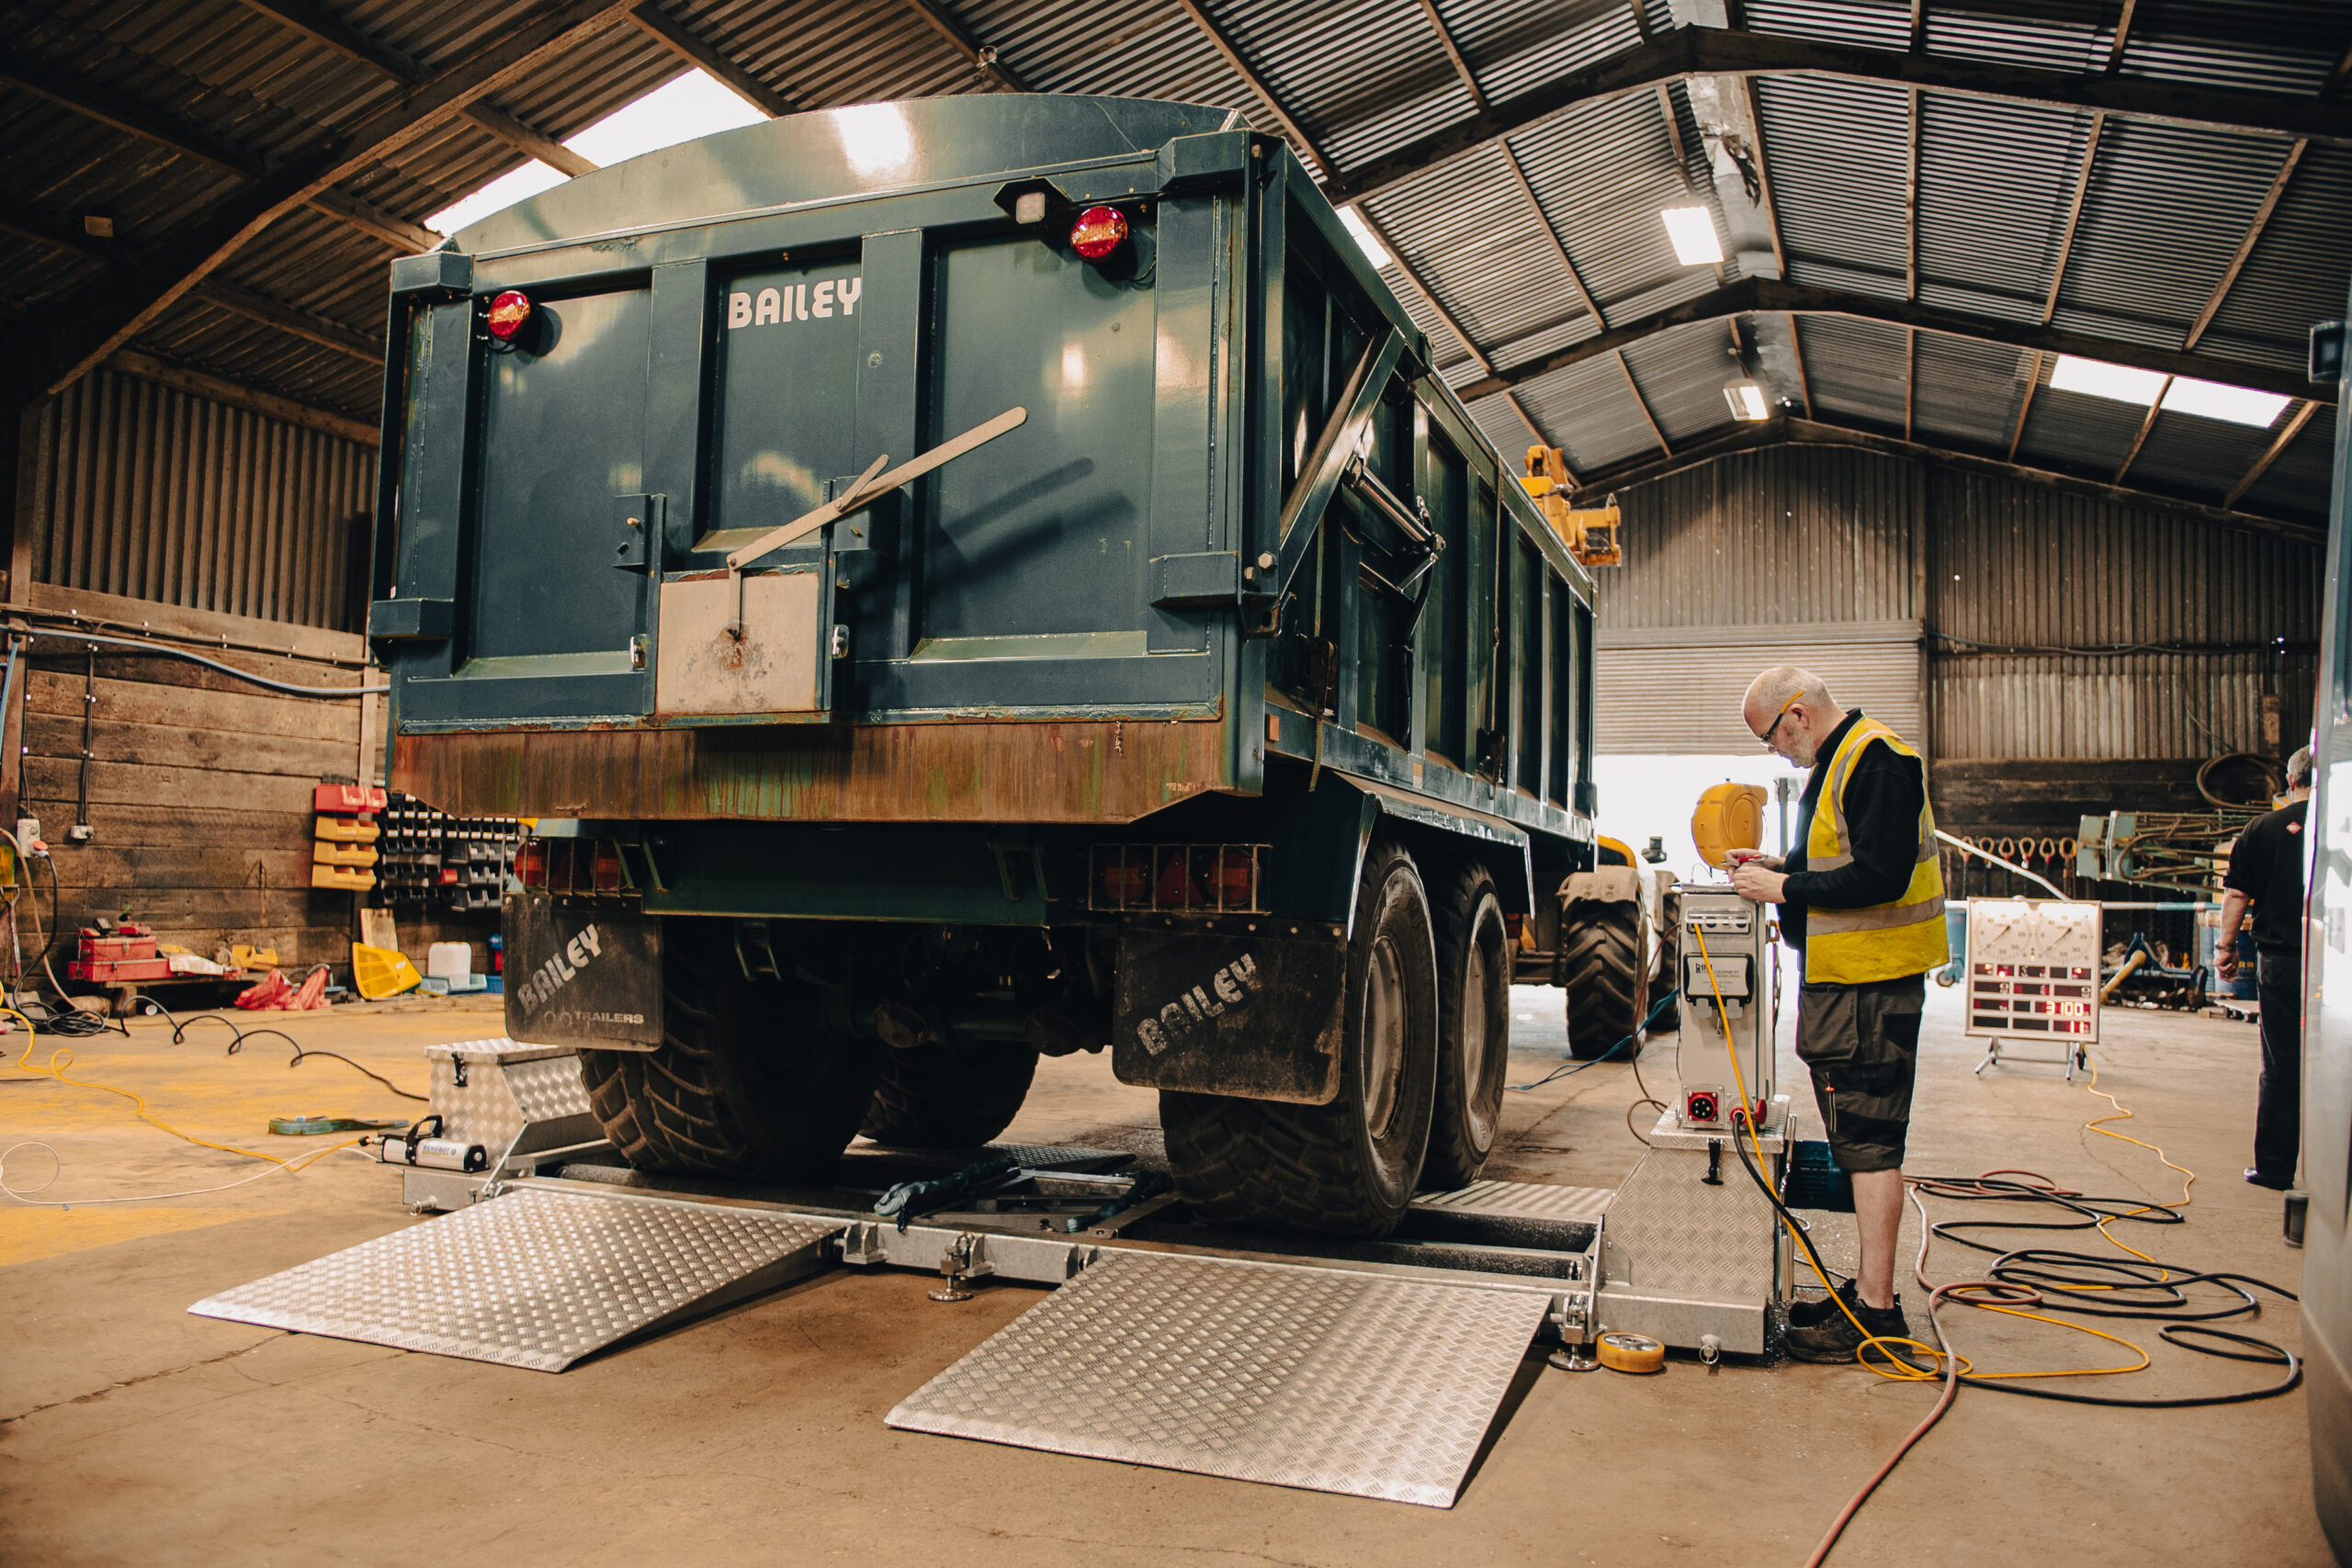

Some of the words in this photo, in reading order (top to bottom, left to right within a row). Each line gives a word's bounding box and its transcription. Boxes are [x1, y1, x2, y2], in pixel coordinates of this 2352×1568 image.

[728, 276, 862, 330] BAILEY
[517, 923, 602, 1016] BAILEY
[573, 1011, 645, 1025] TRAILERS
[1136, 953, 1261, 1056] BAILEY
[2045, 1000, 2084, 1017] 3100
